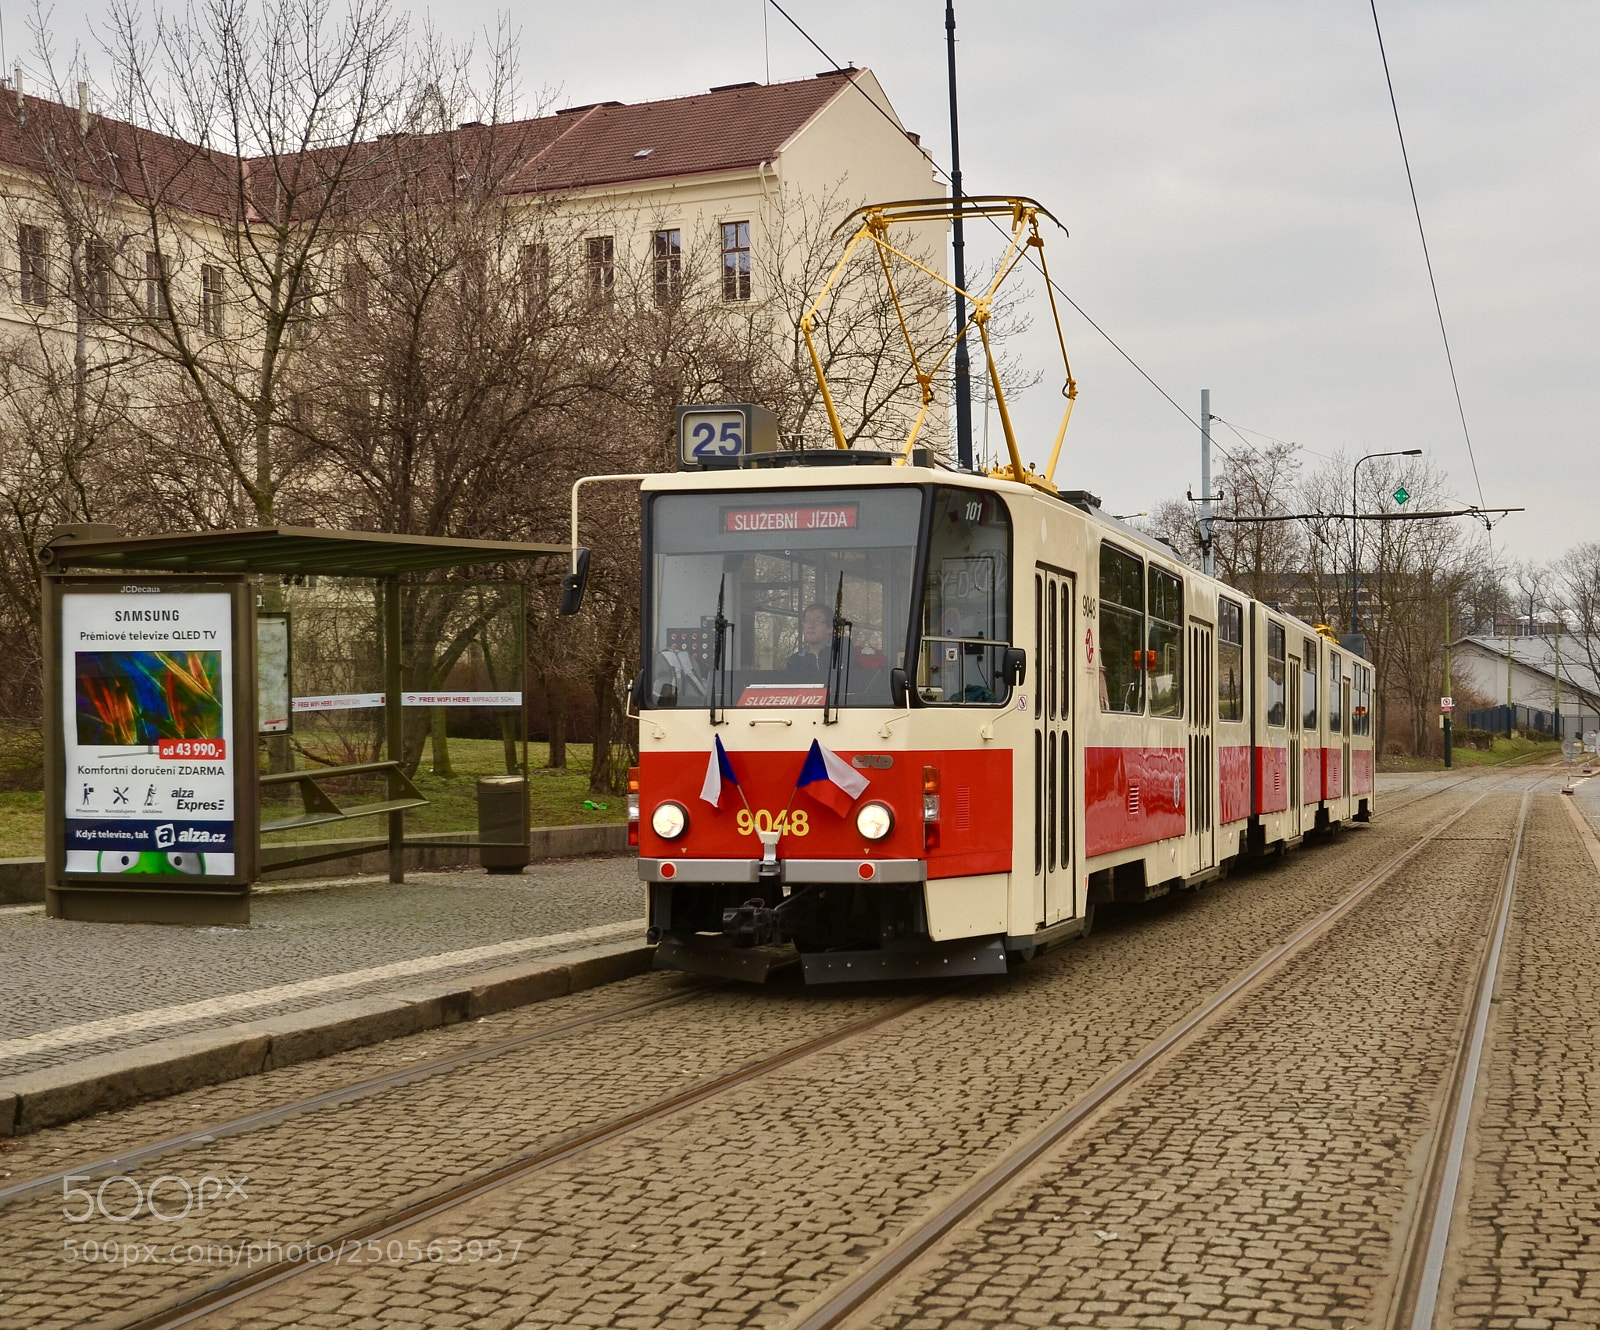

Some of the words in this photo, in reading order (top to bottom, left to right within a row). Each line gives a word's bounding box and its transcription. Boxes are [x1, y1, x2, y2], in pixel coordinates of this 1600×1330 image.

[691, 421, 743, 458] 25
[965, 501, 982, 521] 101
[734, 511, 799, 531] SLUŽEBNÍ
[806, 510, 848, 528] JÍZDA
[120, 585, 161, 593] JCDecaux
[115, 609, 180, 622] SAMSUNG
[80, 631, 127, 641] Prémiové
[129, 631, 169, 640] televize
[172, 630, 201, 640] QLED
[202, 630, 217, 640] TV
[163, 745, 174, 756] od
[176, 743, 191, 756] 43
[193, 743, 223, 758] 990,-
[77, 765, 129, 775] Komfortní
[131, 766, 176, 775] doručení
[178, 766, 225, 775] ZDARMA
[171, 787, 194, 798] alza
[736, 808, 810, 837] 9048
[75, 829, 97, 840] Když
[98, 830, 134, 840] televize,
[135, 831, 149, 839] tak
[178, 828, 227, 843] alza.cz
